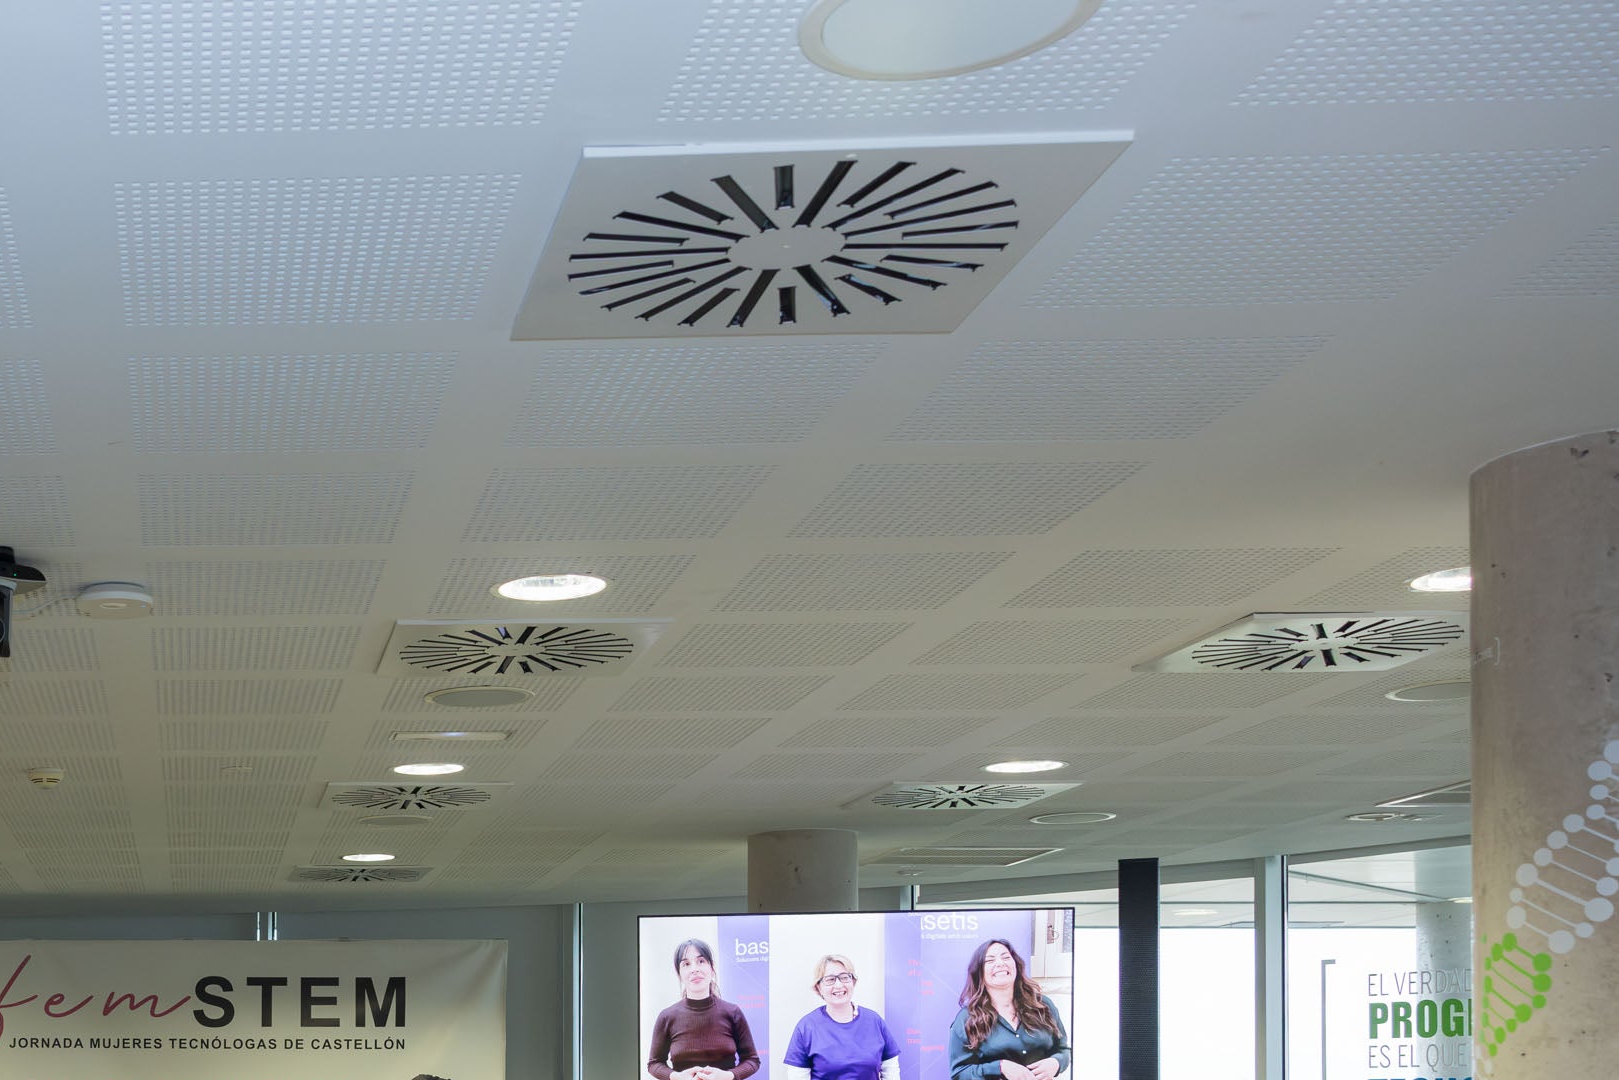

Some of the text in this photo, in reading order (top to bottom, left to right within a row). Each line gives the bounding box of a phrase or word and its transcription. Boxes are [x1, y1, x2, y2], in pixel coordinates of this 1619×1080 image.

[735, 938, 769, 957] bas
[1368, 973, 1389, 996] EL
[9, 1036, 406, 1050] JORNADA MUJERES TECNÓLOGAS DE CASTELLÓN
[1369, 1042, 1468, 1073] ES EL QUE
